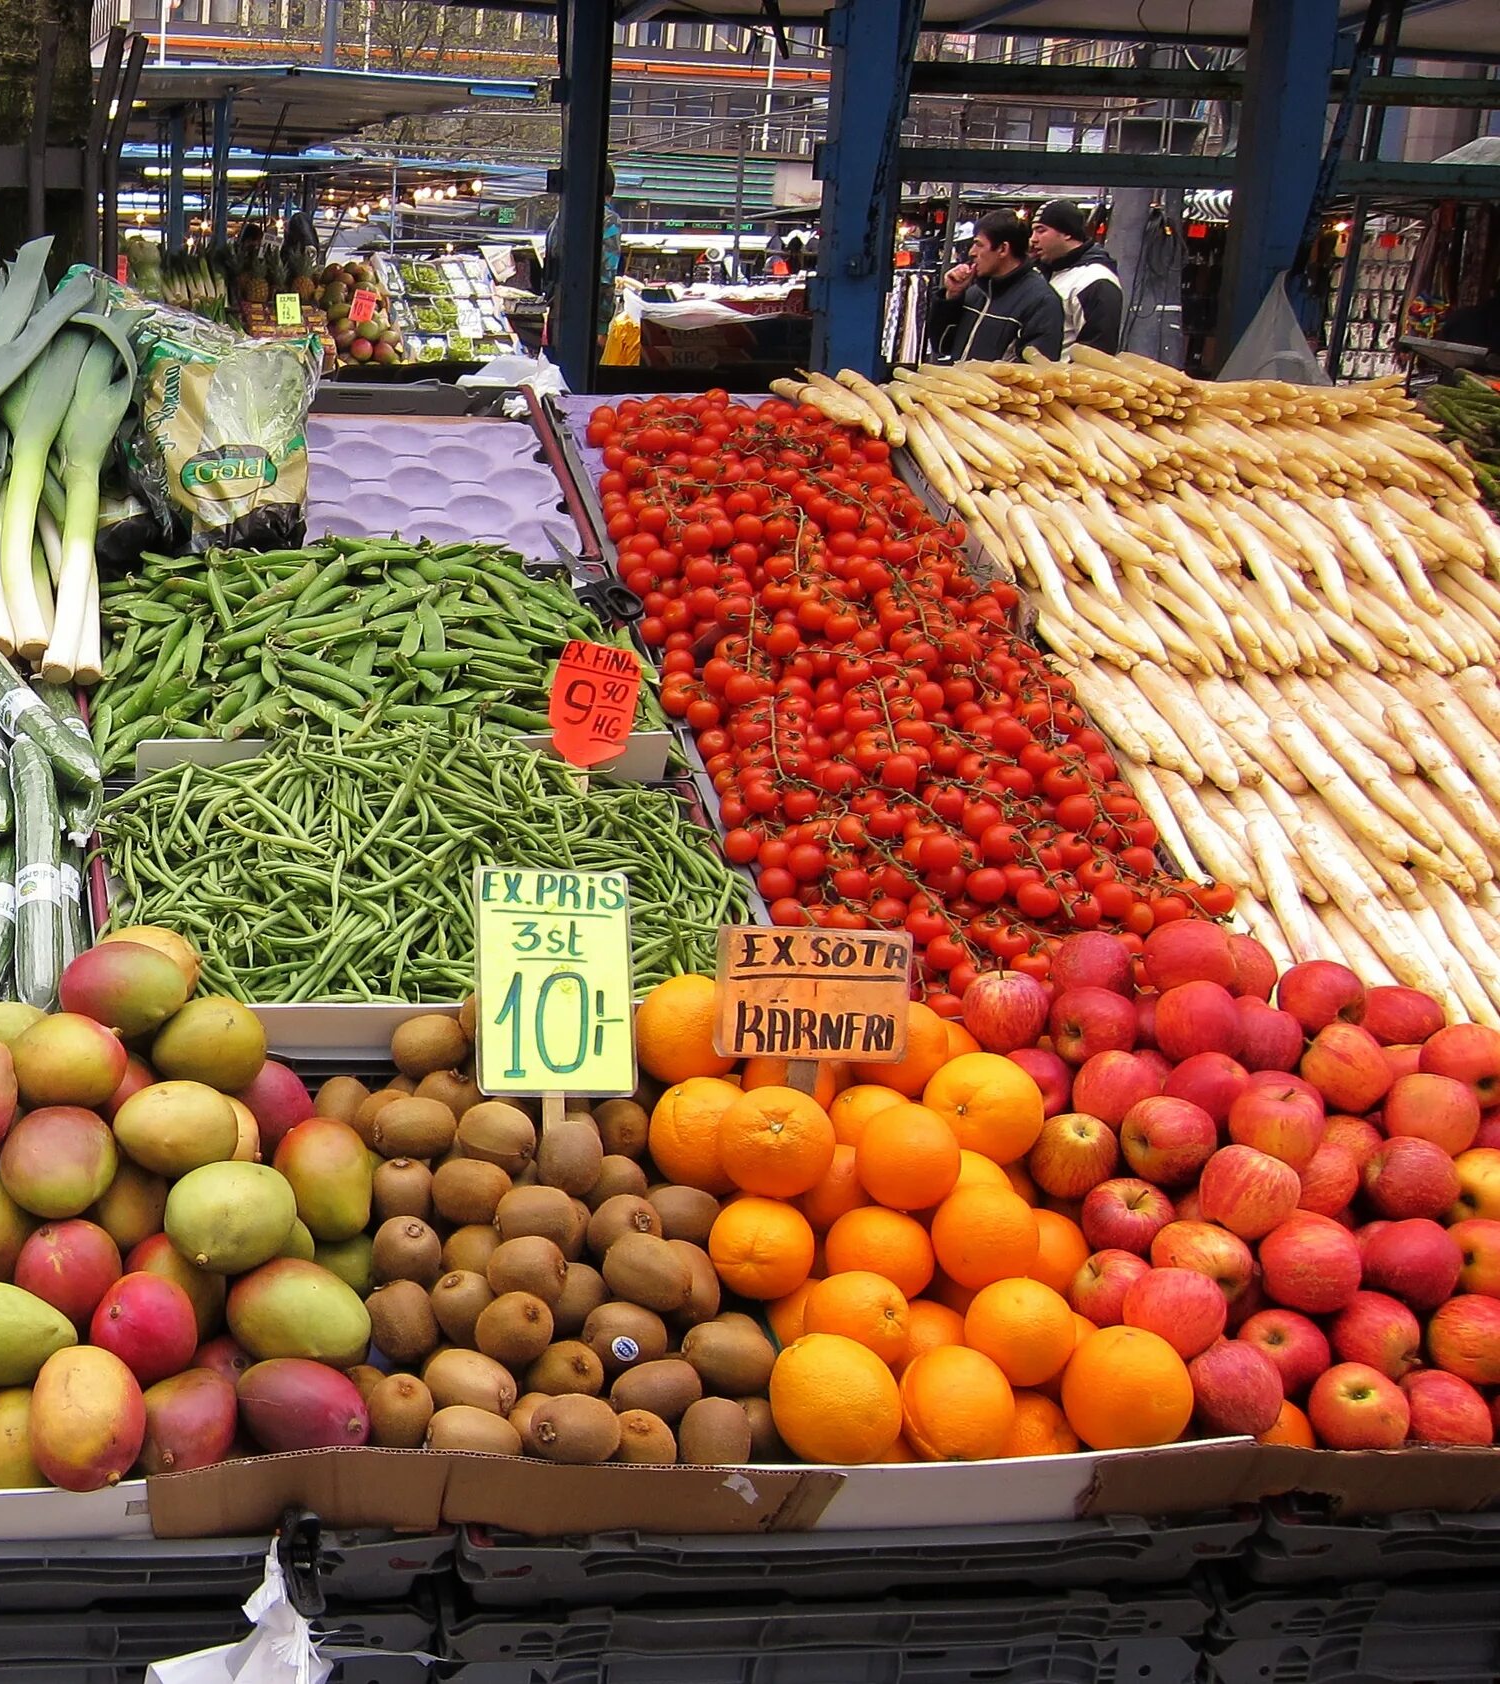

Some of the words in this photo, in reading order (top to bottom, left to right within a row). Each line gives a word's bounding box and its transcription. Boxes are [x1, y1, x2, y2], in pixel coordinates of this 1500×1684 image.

[194, 456, 263, 484] Gold
[563, 679, 597, 726] 9
[601, 681, 630, 704] 90
[591, 713, 622, 739] HG
